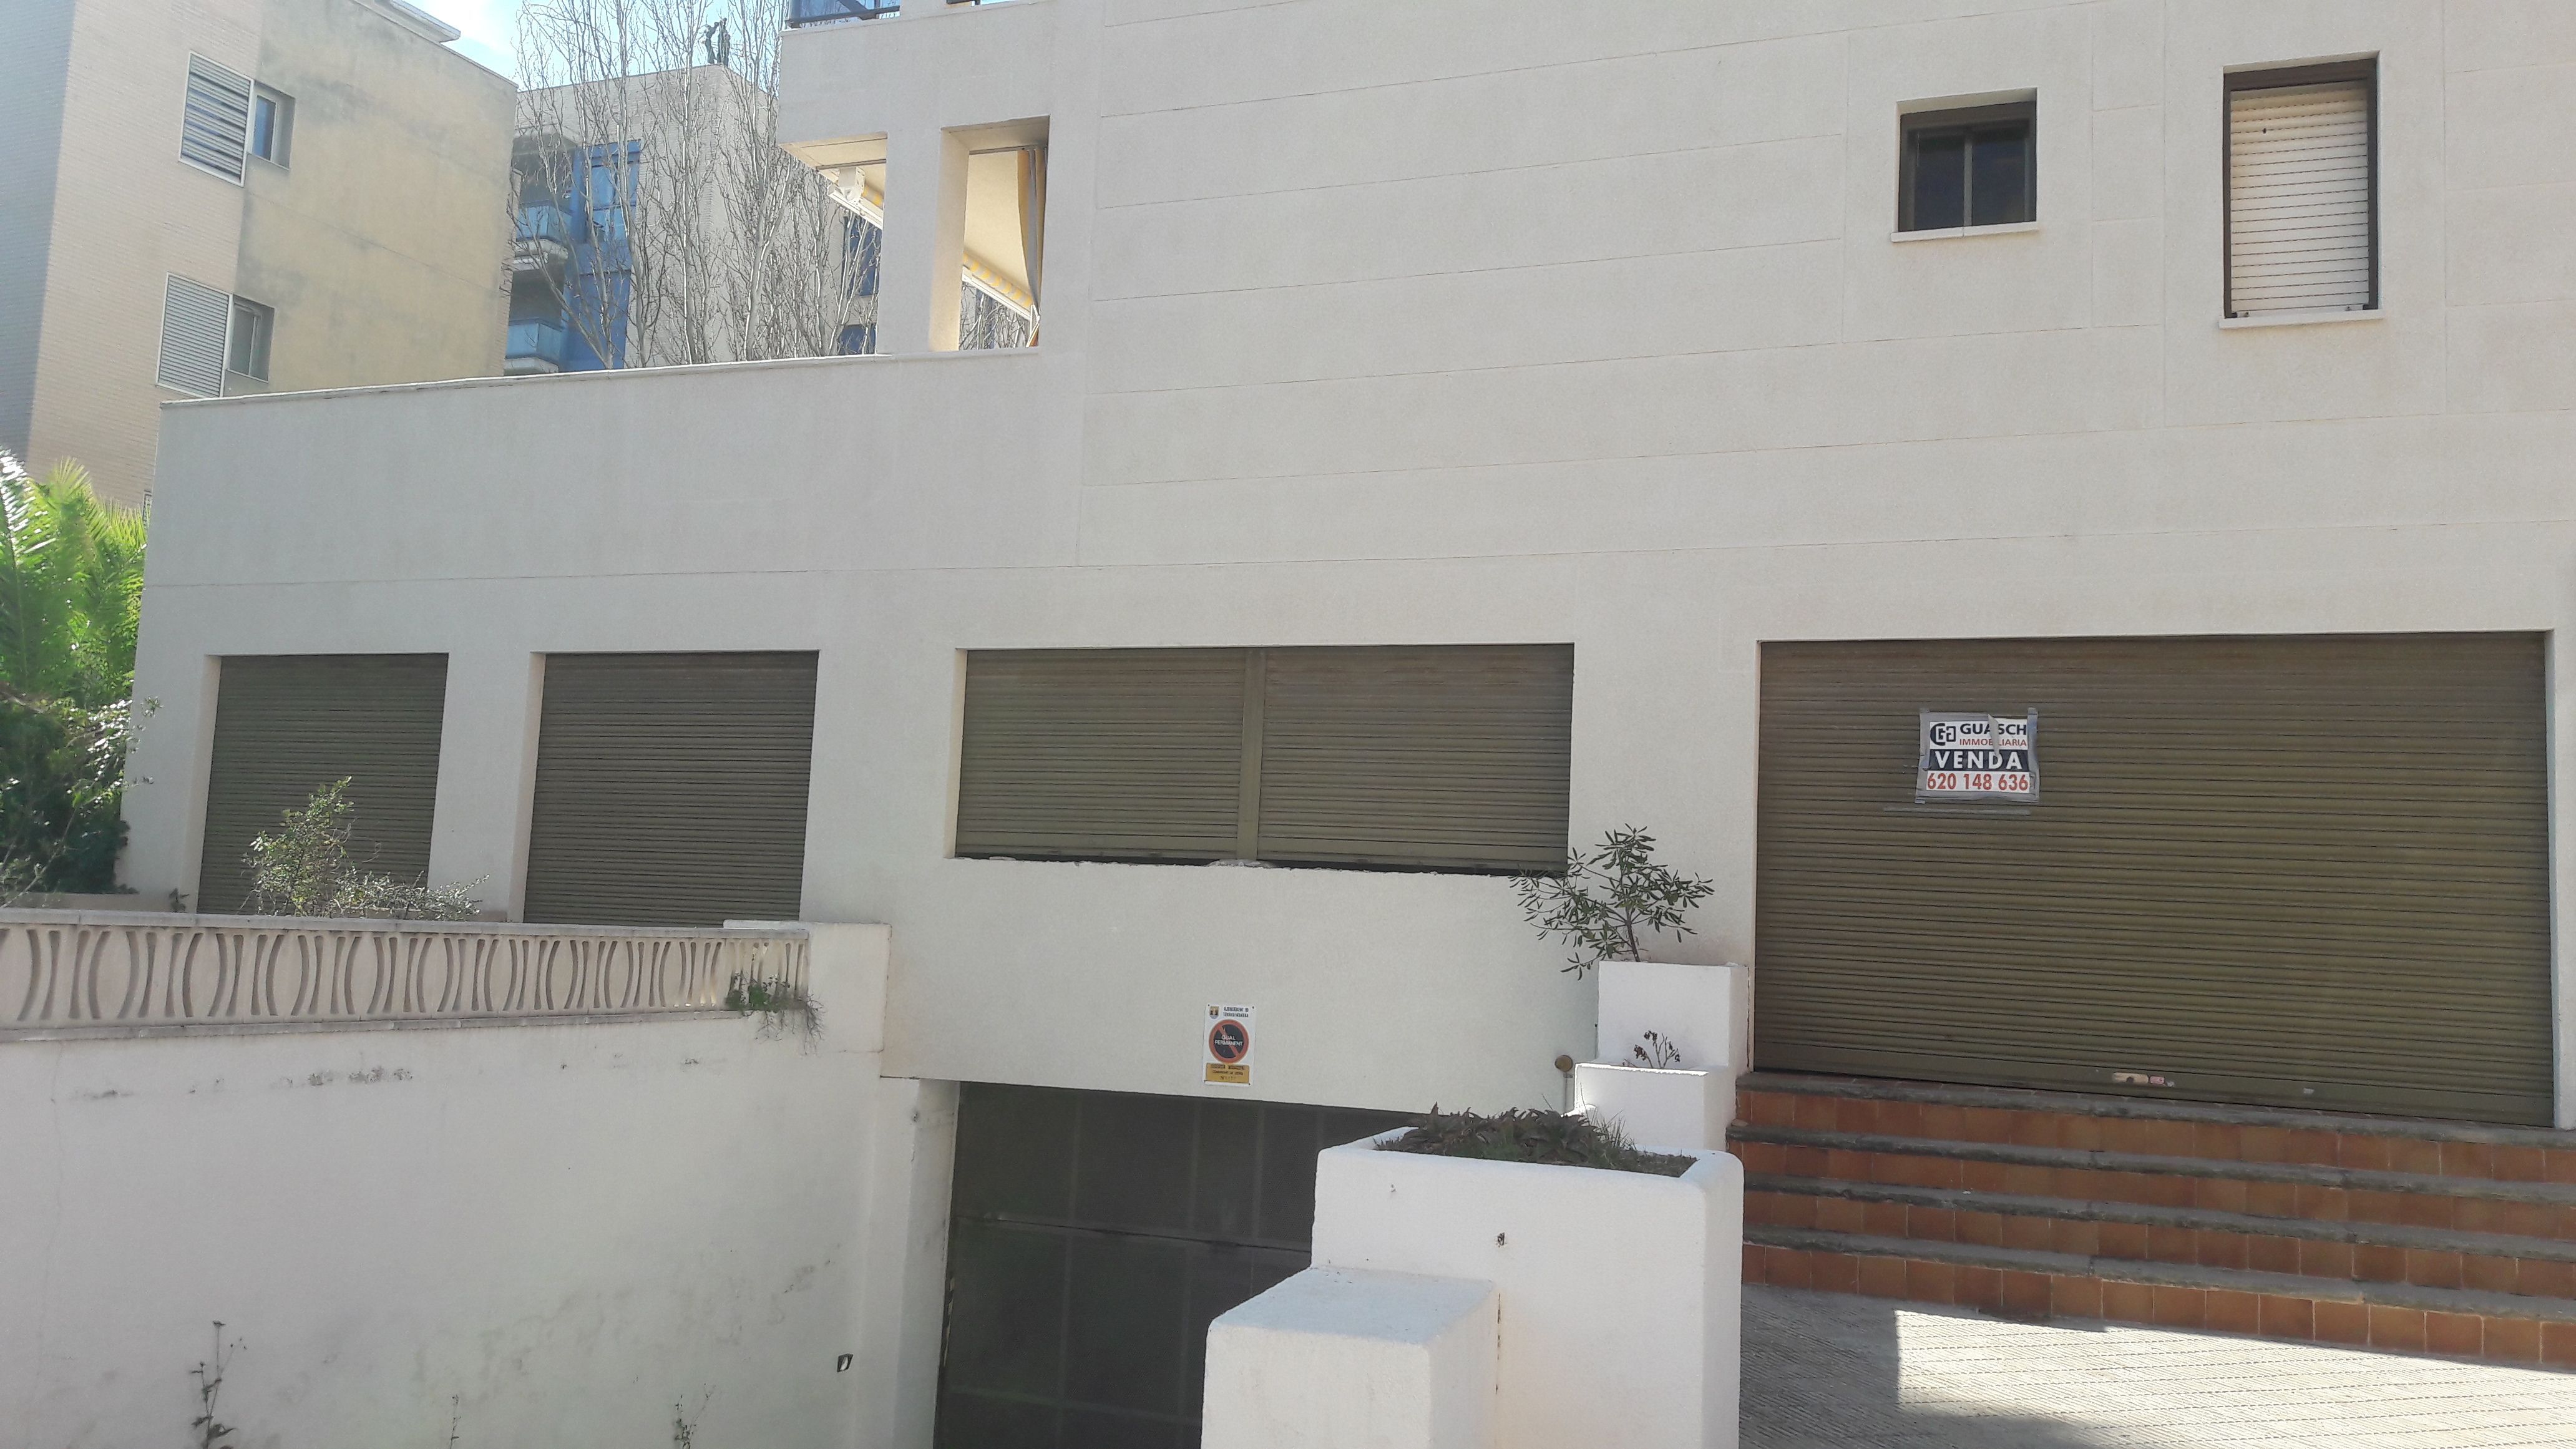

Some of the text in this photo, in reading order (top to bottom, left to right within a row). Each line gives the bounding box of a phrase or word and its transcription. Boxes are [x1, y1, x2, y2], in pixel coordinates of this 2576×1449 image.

[1935, 751, 2022, 769] VENDA
[1927, 773, 2028, 791] 620 148 636
